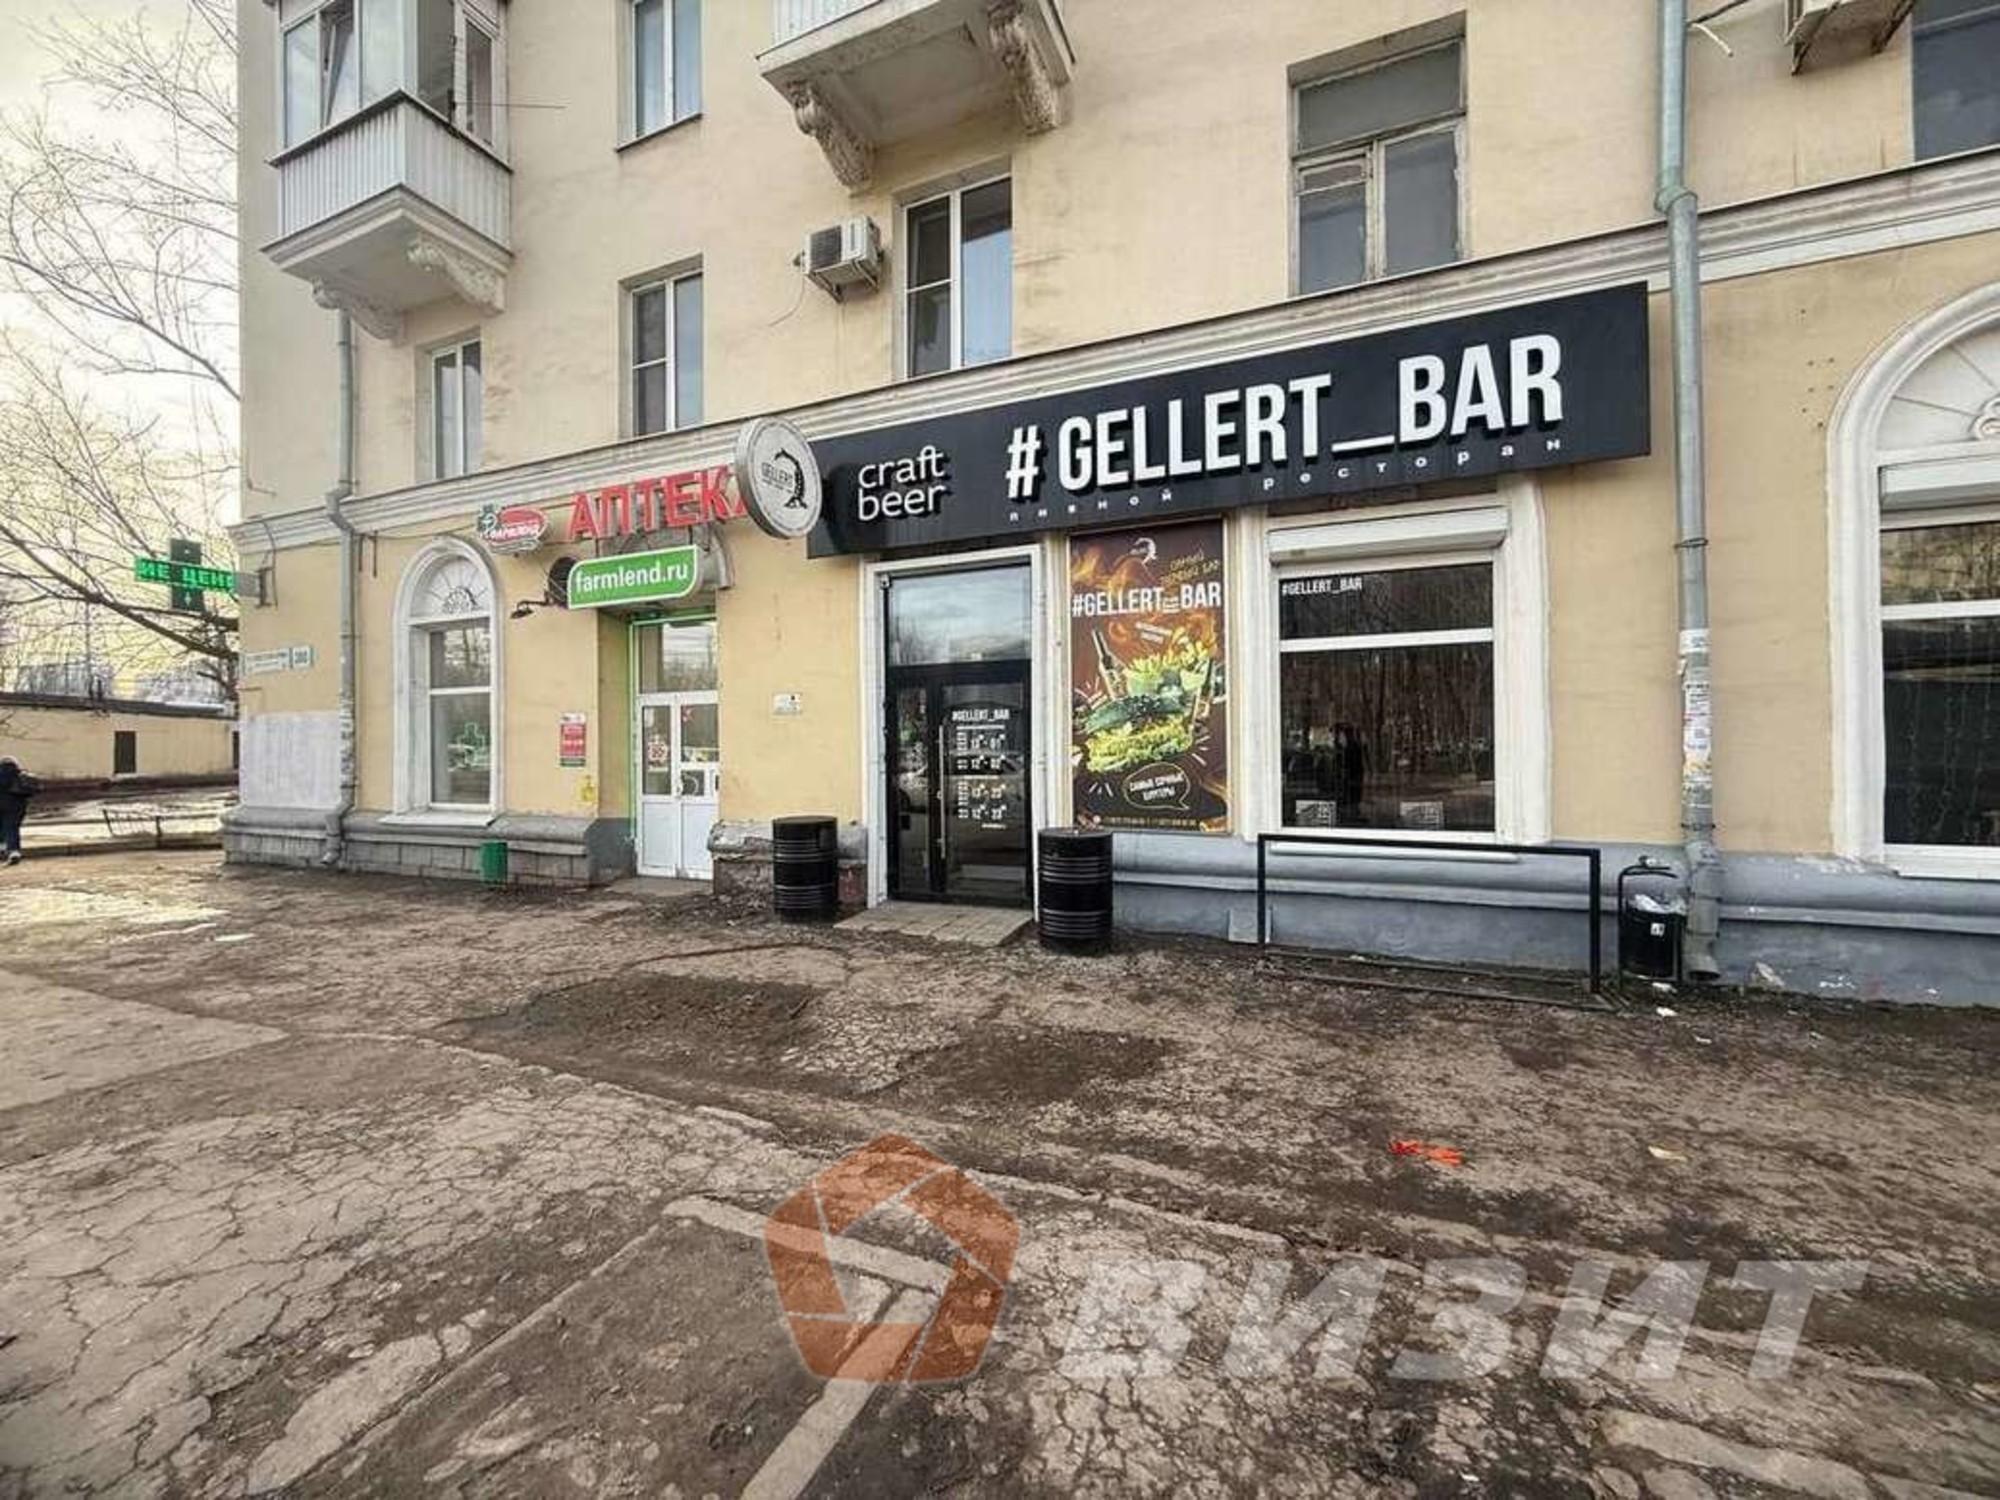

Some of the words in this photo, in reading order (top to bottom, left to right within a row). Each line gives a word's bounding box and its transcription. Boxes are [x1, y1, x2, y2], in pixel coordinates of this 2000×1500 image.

[1058, 334, 1564, 491] GELLERT_BAR
[858, 445, 945, 489] craft
[1263, 439, 1561, 491] ресторан
[858, 484, 947, 522] beer
[575, 558, 690, 593] farmlend.ru
[1282, 577, 1363, 596] #GELLERT_BAR
[1072, 582, 1222, 617] #GELLERT_BAR
